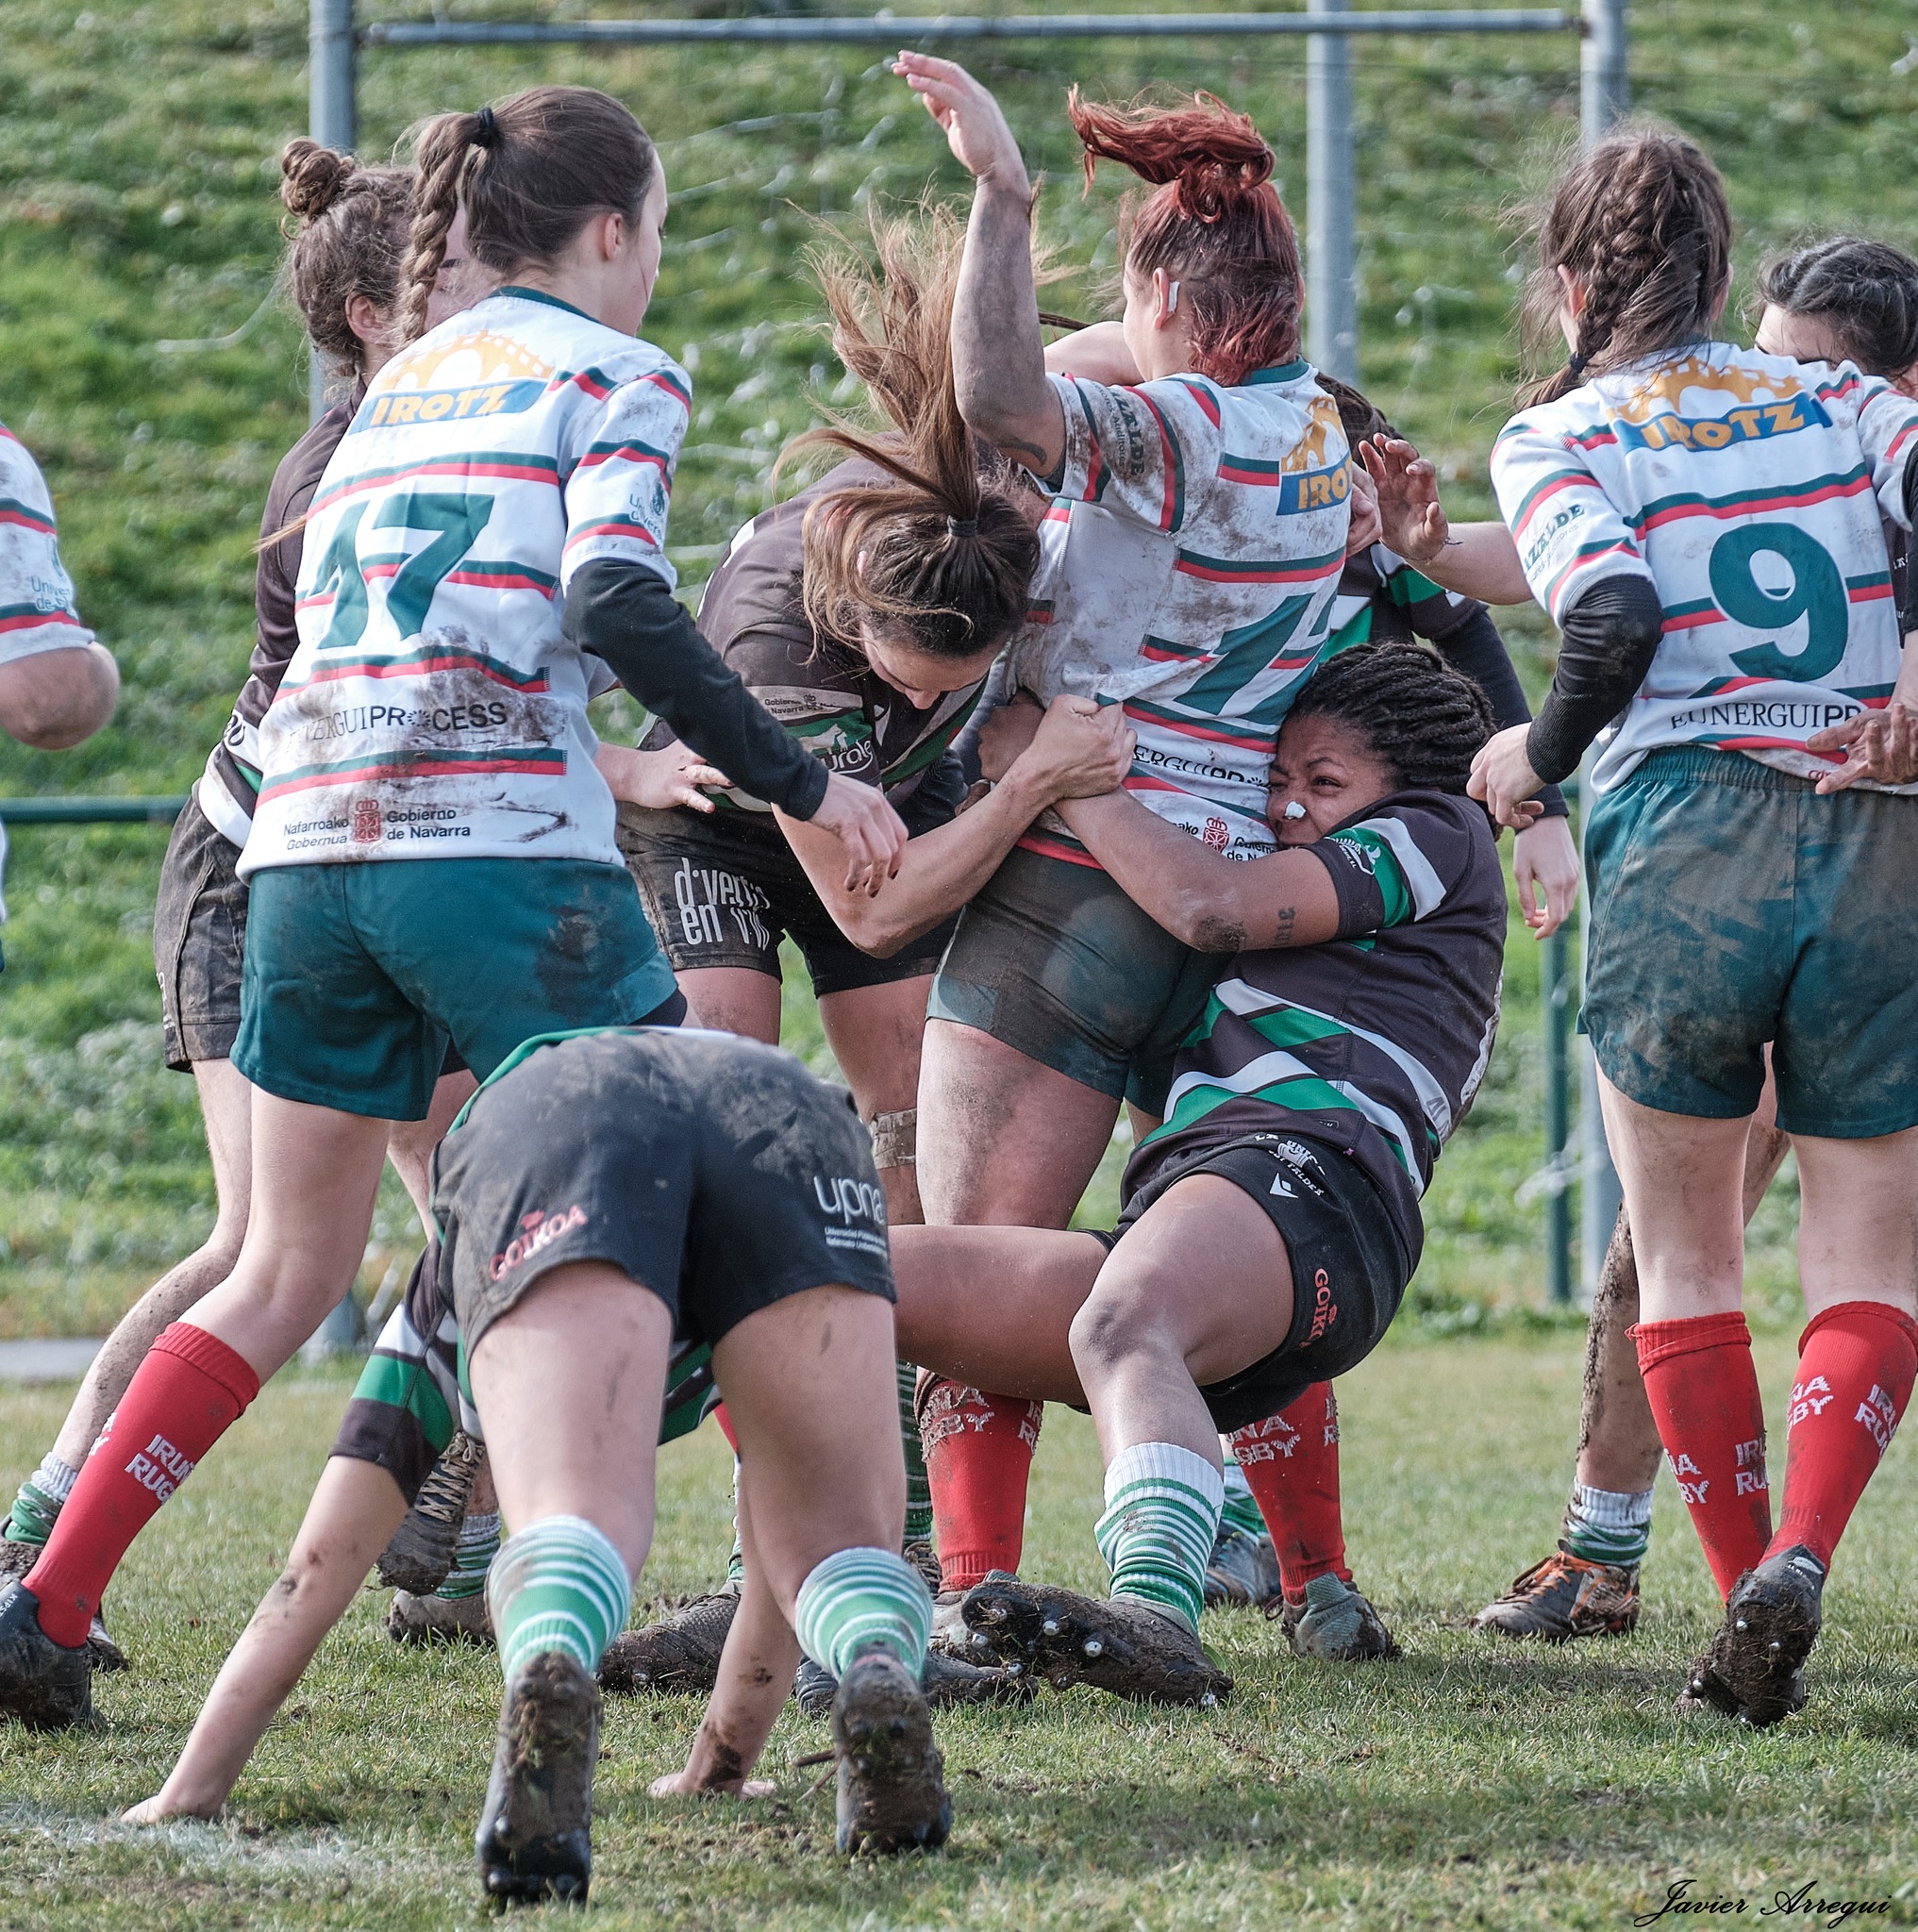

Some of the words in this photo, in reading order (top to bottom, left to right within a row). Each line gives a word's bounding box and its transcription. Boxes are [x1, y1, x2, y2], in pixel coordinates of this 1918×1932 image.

[371, 384, 515, 425] IROTZ
[1641, 402, 1805, 449] IROTZ
[309, 492, 495, 650] 17
[1709, 522, 1849, 682] 9
[284, 816, 350, 836] Nafarroako
[387, 809, 457, 823] Gobierno
[387, 829, 405, 841] de
[410, 826, 471, 839] Navarra
[287, 833, 348, 850] Gobernua
[1226, 850, 1243, 861] de
[680, 904, 724, 945] en
[813, 1174, 886, 1224] upna
[490, 1206, 589, 1281] GOIKOA
